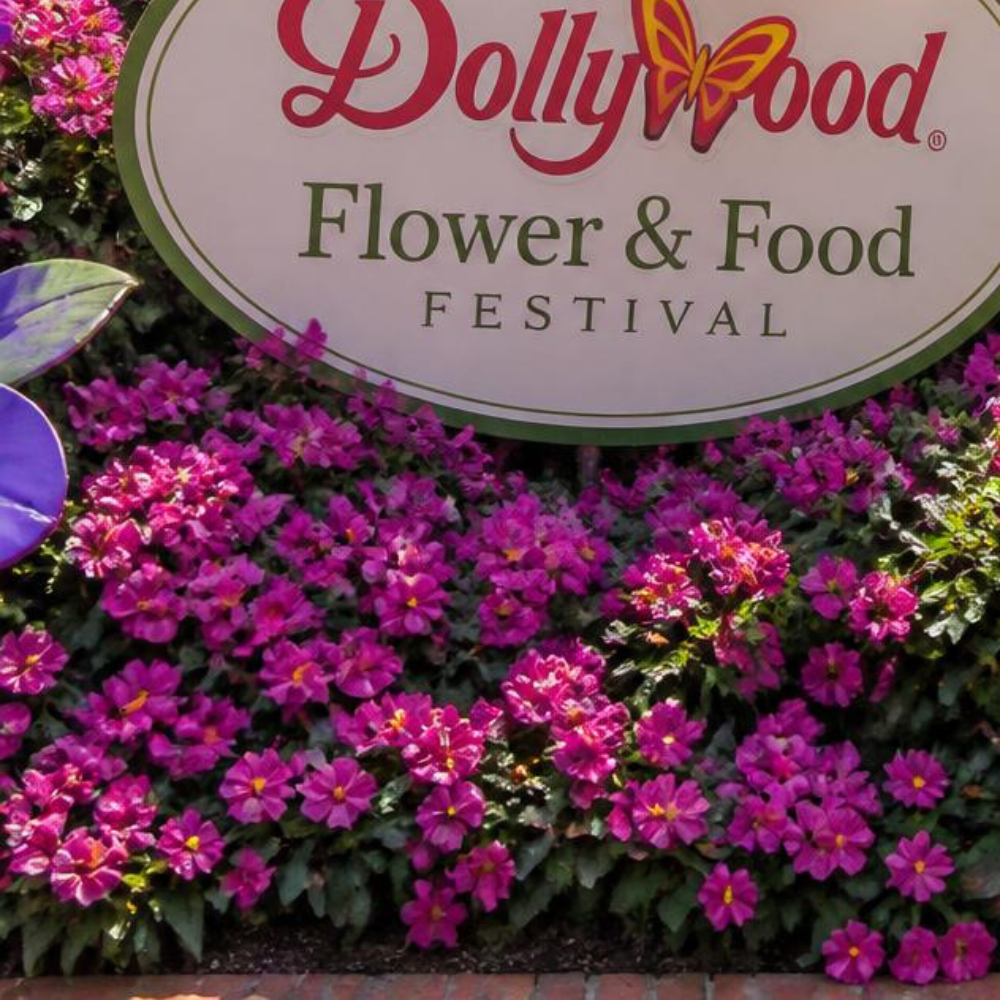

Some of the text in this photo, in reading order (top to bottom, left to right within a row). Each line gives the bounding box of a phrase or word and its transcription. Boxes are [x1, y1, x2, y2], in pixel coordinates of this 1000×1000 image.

[298, 181, 916, 278] Flower & Food
[421, 290, 788, 338] FESTIVAL
